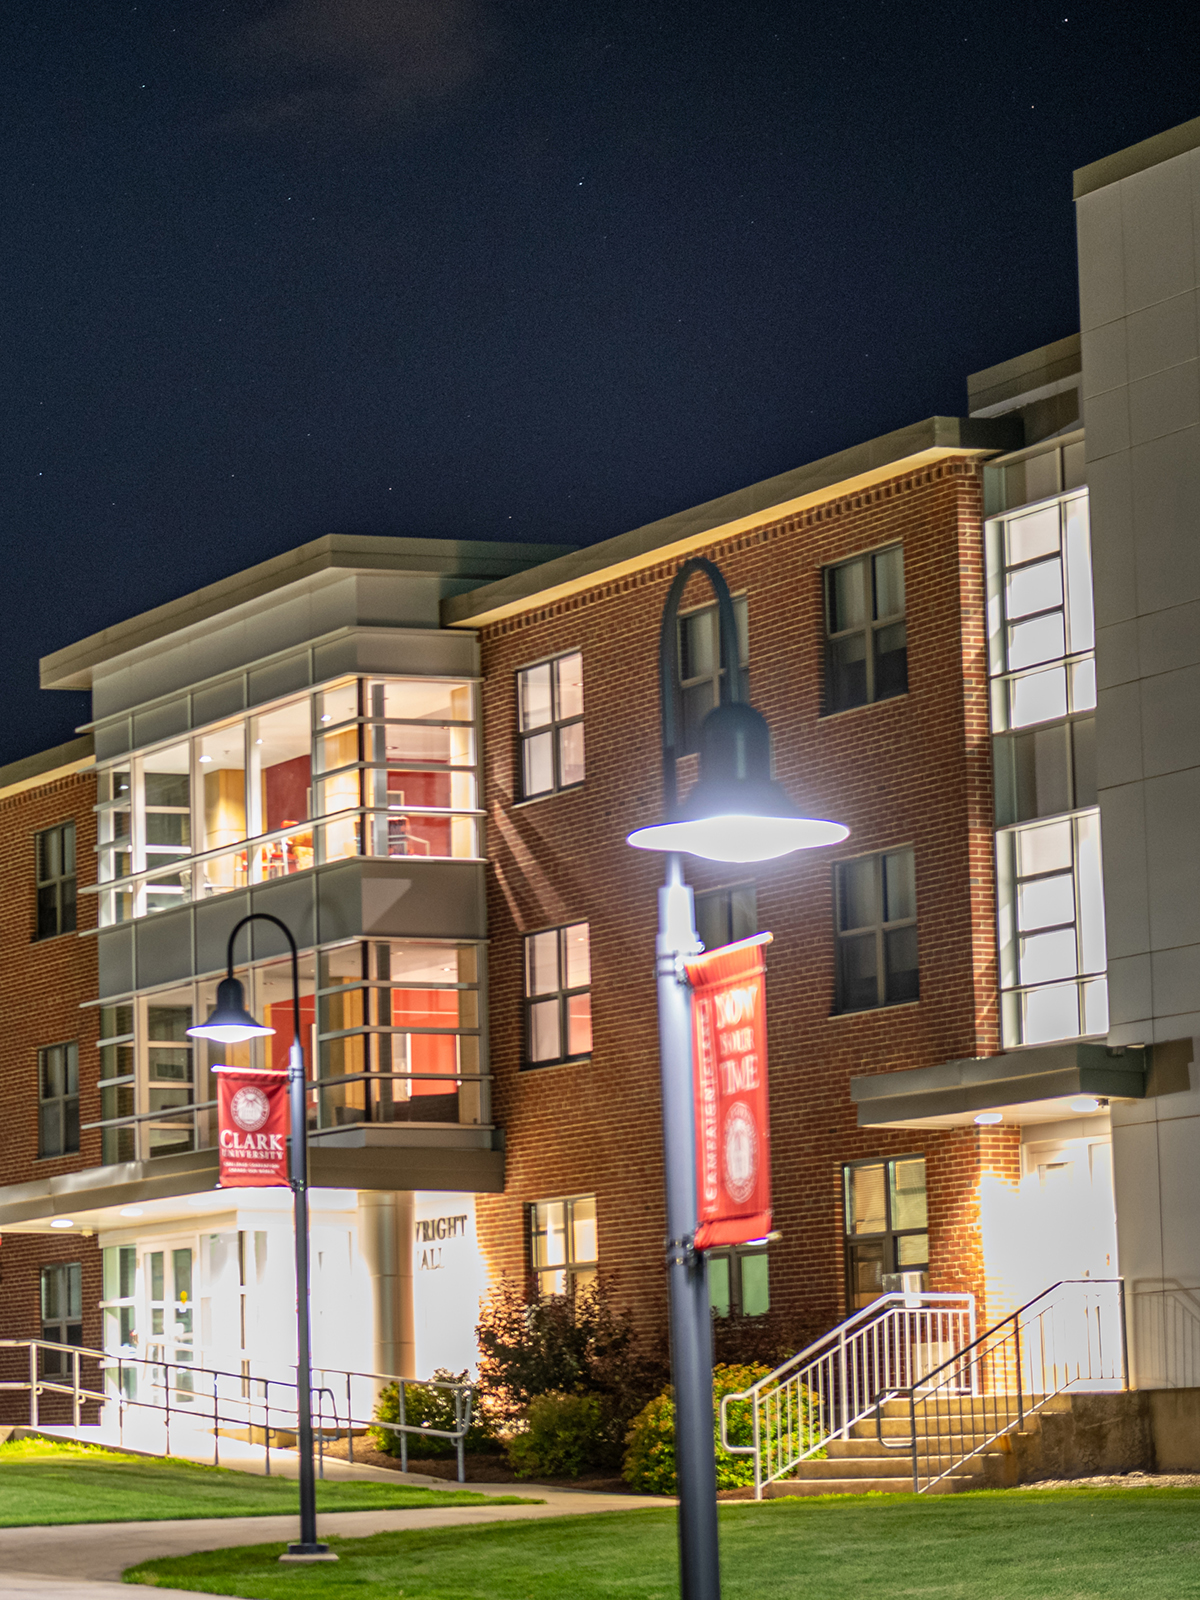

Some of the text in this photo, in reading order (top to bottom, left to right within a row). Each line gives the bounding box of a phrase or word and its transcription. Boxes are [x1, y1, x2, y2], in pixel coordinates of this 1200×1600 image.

[714, 985, 757, 1029] NOW
[719, 1053, 760, 1096] TIME
[220, 1130, 283, 1150] CLARK
[221, 1149, 283, 1160] UNIVERSITY
[704, 1087, 718, 1200] CAMPAIGN
